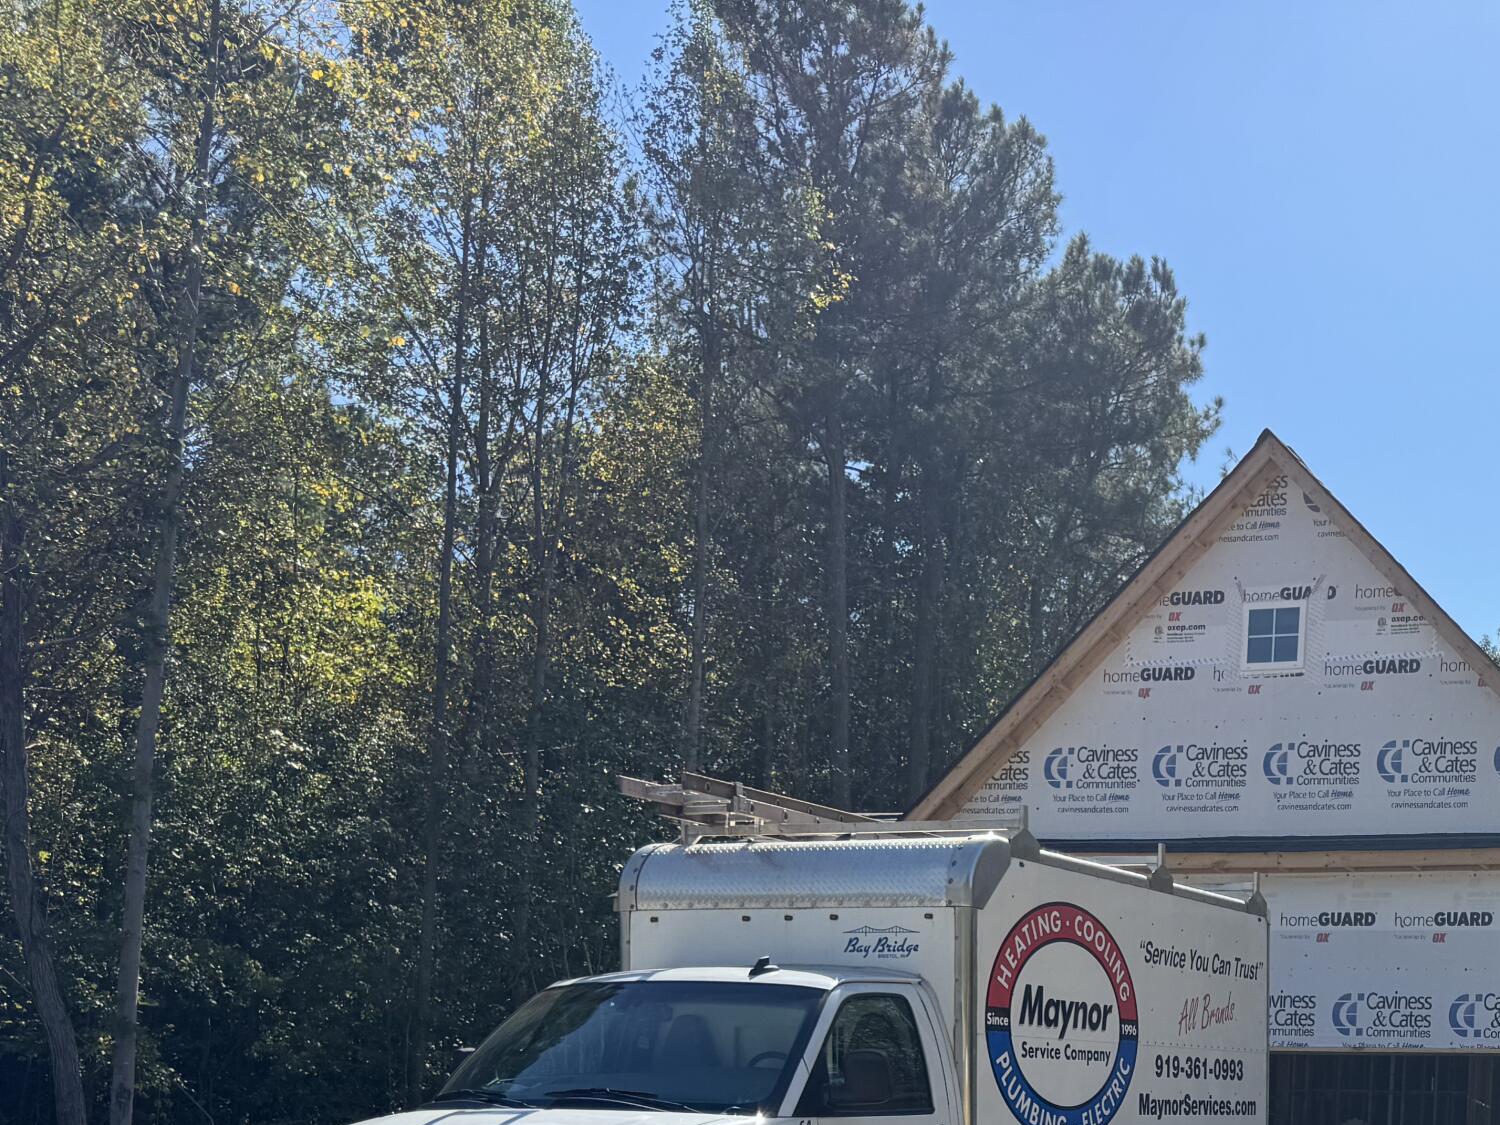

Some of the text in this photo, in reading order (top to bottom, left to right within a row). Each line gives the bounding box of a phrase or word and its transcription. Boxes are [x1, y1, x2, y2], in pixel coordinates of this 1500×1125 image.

[1103, 667, 1196, 682] homeGUARD
[1324, 658, 1421, 676] homeGUARD
[1076, 745, 1138, 763] Caviness
[1186, 743, 1248, 761] Caviness
[1297, 740, 1361, 759] Caviness
[1412, 738, 1478, 756] Caviness
[1082, 763, 1137, 781] & Cates
[1192, 760, 1247, 779] & Cates
[1303, 758, 1360, 776] & Cates
[1418, 755, 1477, 774] & Cates
[1076, 780, 1137, 790] Communities
[1185, 777, 1247, 788] Communities
[1296, 775, 1360, 786] Communities
[1411, 773, 1477, 784] Communities
[1108, 792, 1130, 802] Home
[1161, 791, 1240, 801] Your Place to Call Home
[1272, 789, 1354, 800] Your Place to Call Home
[1387, 787, 1470, 798] Your Place to Call Home
[1166, 804, 1239, 813] cavinessandcates.com
[1277, 803, 1352, 811] cavinessandcates.com
[1391, 801, 1469, 809] cavinessandcates.com
[1280, 912, 1376, 927] homeGUARD
[1394, 911, 1493, 928] homeGUARD
[843, 936, 920, 958] Bay Bridge
[997, 910, 1130, 1002] HEATING COOLING
[1190, 948, 1210, 972] You
[1211, 953, 1232, 976] Can
[1366, 990, 1432, 1010] Caviness
[986, 1012, 1009, 1026] Since
[1018, 983, 1113, 1040] Maynor
[1178, 991, 1236, 1037] All Brands
[1274, 1009, 1315, 1028] Cates
[1373, 1010, 1432, 1028] & Cates
[1121, 1024, 1137, 1036] 1996
[1366, 1027, 1432, 1039] Communities
[1021, 1041, 1111, 1067] Service Company
[1155, 1054, 1244, 1081] 919-361-0993
[1138, 1093, 1256, 1120] MaynorServices.com
